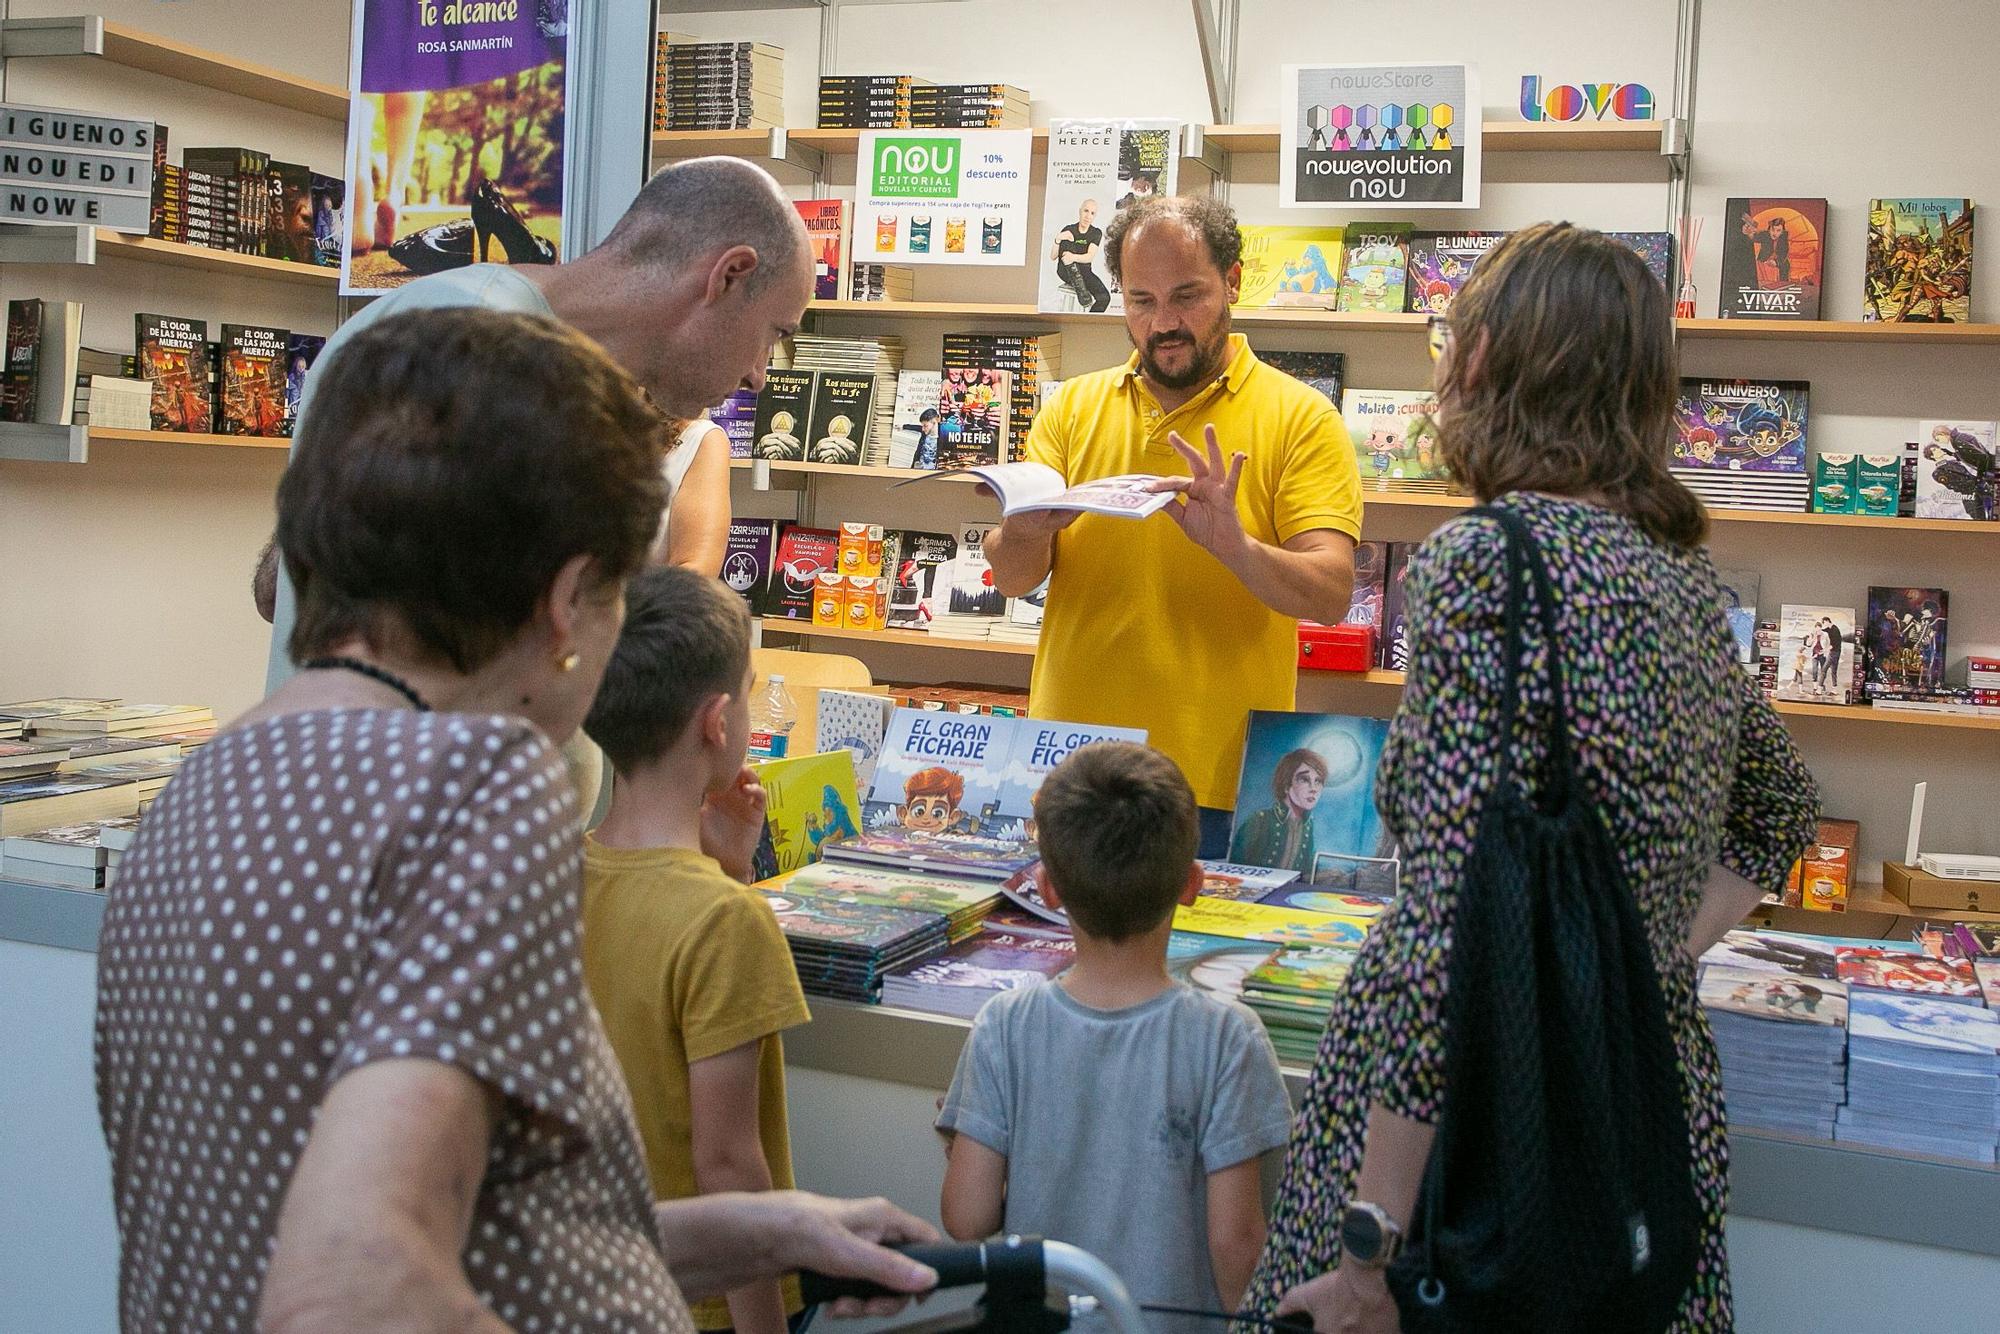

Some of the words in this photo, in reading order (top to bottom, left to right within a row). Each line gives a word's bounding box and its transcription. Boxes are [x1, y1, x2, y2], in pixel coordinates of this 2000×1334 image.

[418, 0, 438, 27] Te
[443, 0, 518, 26] alcance
[417, 40, 448, 54] ROSA
[449, 36, 513, 53] SANMARTÍN
[1059, 137, 1111, 145] HERCE
[983, 154, 1003, 164] 10%
[1305, 155, 1452, 175] nowevolution
[4, 155, 135, 184] NOUEDI
[966, 169, 1018, 179] descuento
[879, 176, 951, 186] EDITORIAL
[10, 193, 98, 219] NOWE
[869, 200, 890, 208] Compra
[1921, 202, 1947, 213] lobos
[820, 206, 839, 217] LIBROS
[1359, 234, 1398, 248] TROY
[1436, 236, 1450, 248] EL
[1452, 236, 1507, 249] UNIVERS
[1742, 293, 1796, 312] VIVAR
[160, 320, 169, 329] EL
[169, 321, 191, 332] OLOR
[150, 327, 160, 337] DE
[160, 328, 175, 338] LAS
[176, 331, 203, 342] HOJAS
[244, 329, 253, 338] EL
[253, 331, 275, 341] OLOR
[158, 337, 193, 350] MUERTAS
[233, 337, 244, 346] DE
[244, 338, 259, 348] LAS
[259, 340, 285, 350] HOJAS
[241, 346, 275, 358] MUERTAS
[780, 374, 809, 385] números
[825, 378, 839, 388] Los
[840, 378, 869, 389] números
[773, 383, 781, 392] de
[832, 387, 840, 396] de
[1700, 383, 1715, 396] EL
[1718, 384, 1780, 399] UNIVERSO
[948, 431, 961, 443] NO
[961, 432, 973, 443] TE
[973, 430, 992, 444] FÍES
[911, 718, 932, 736] EL
[939, 721, 991, 741] GRAN
[1036, 730, 1058, 748] EL
[1065, 733, 1120, 749] GR
[905, 735, 988, 760] FICHAJE
